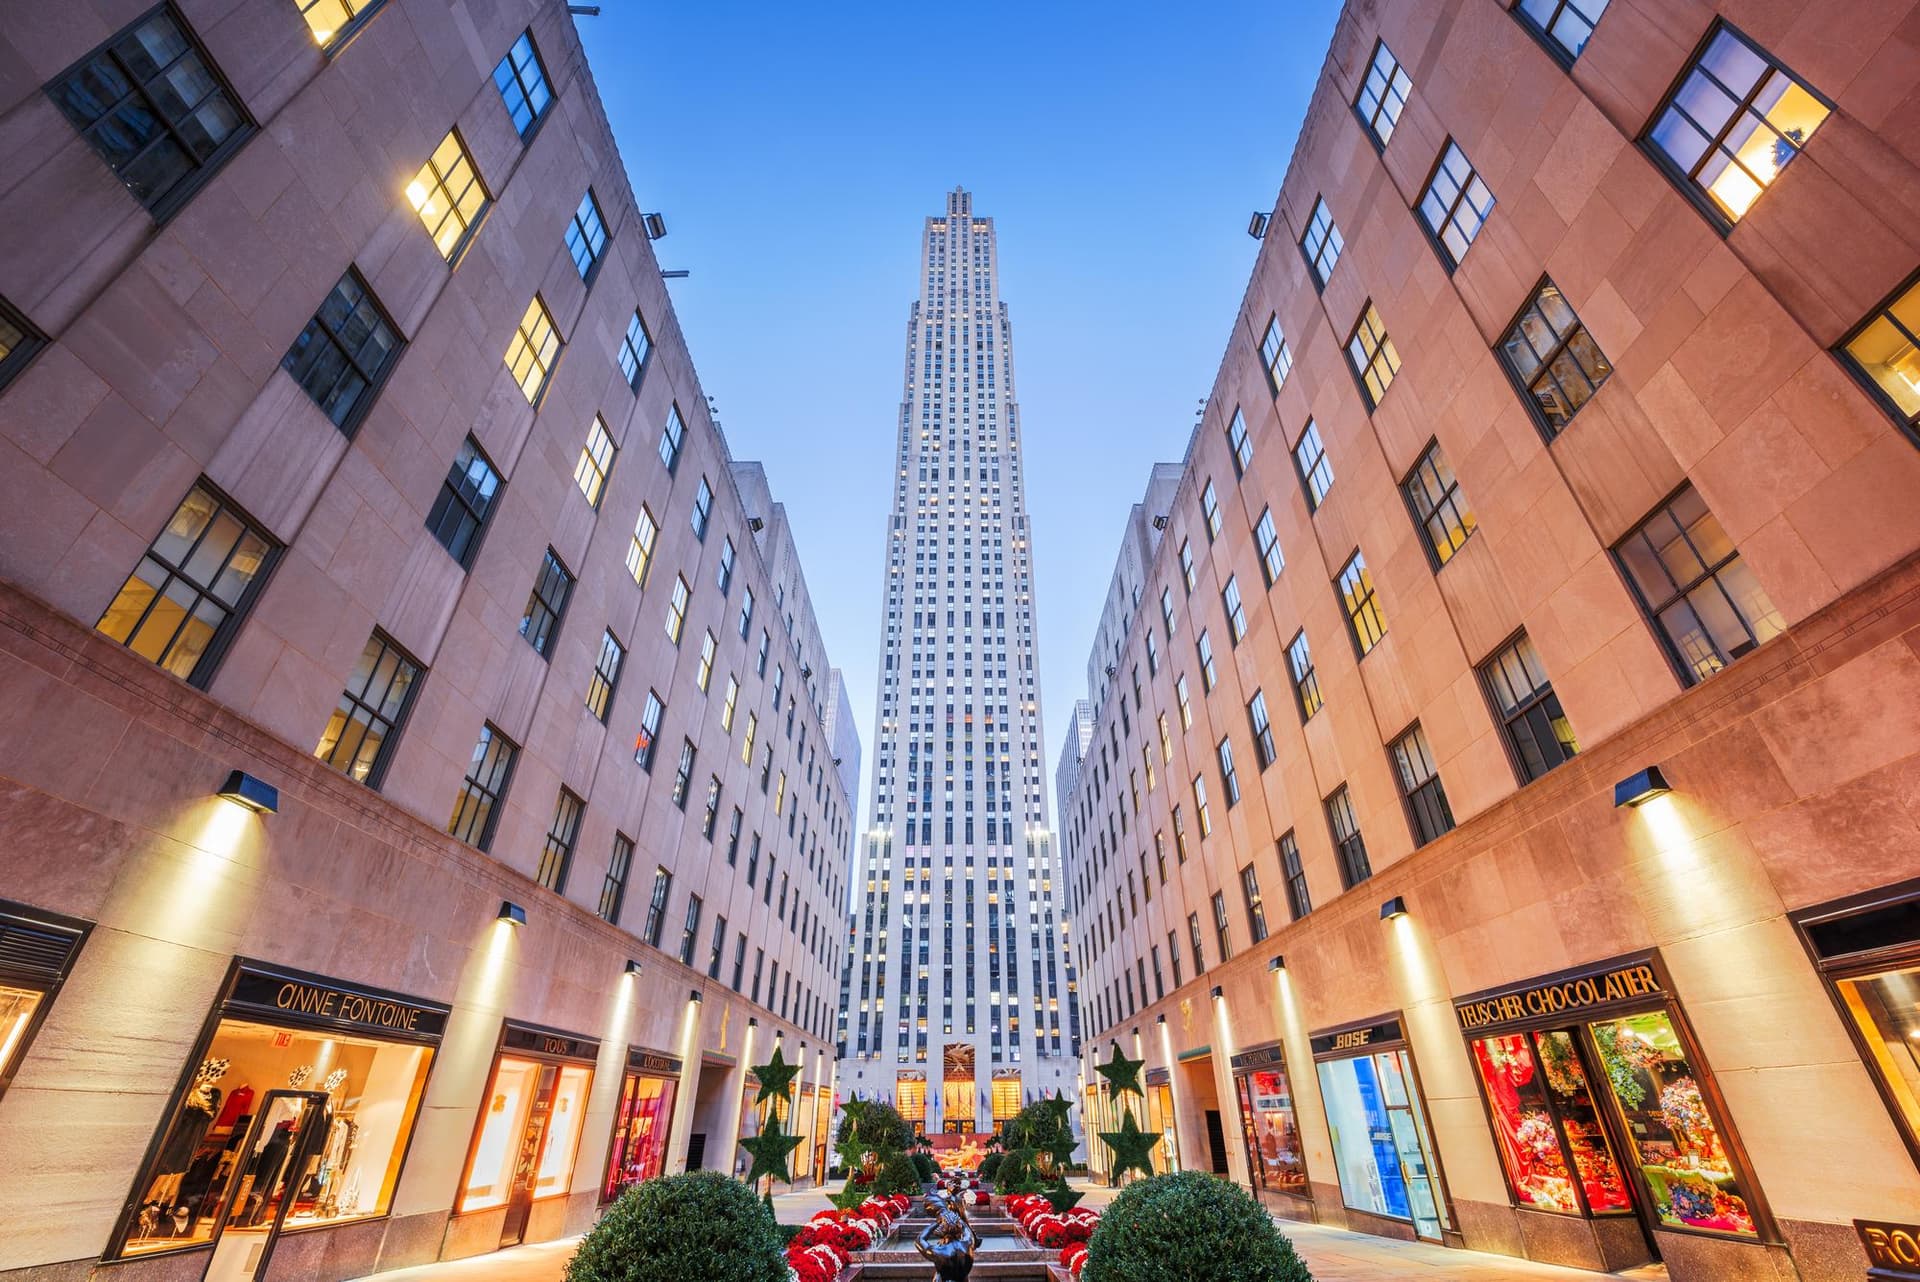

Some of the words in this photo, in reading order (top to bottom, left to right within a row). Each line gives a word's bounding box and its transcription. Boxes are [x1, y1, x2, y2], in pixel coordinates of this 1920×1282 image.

[1458, 994, 1528, 1028] TEUSCHER
[1526, 965, 1660, 1015] CHOCOLATIER
[544, 1037, 569, 1054] TOUS
[1331, 1028, 1373, 1050] BOSE
[1864, 1226, 1920, 1267] RO
